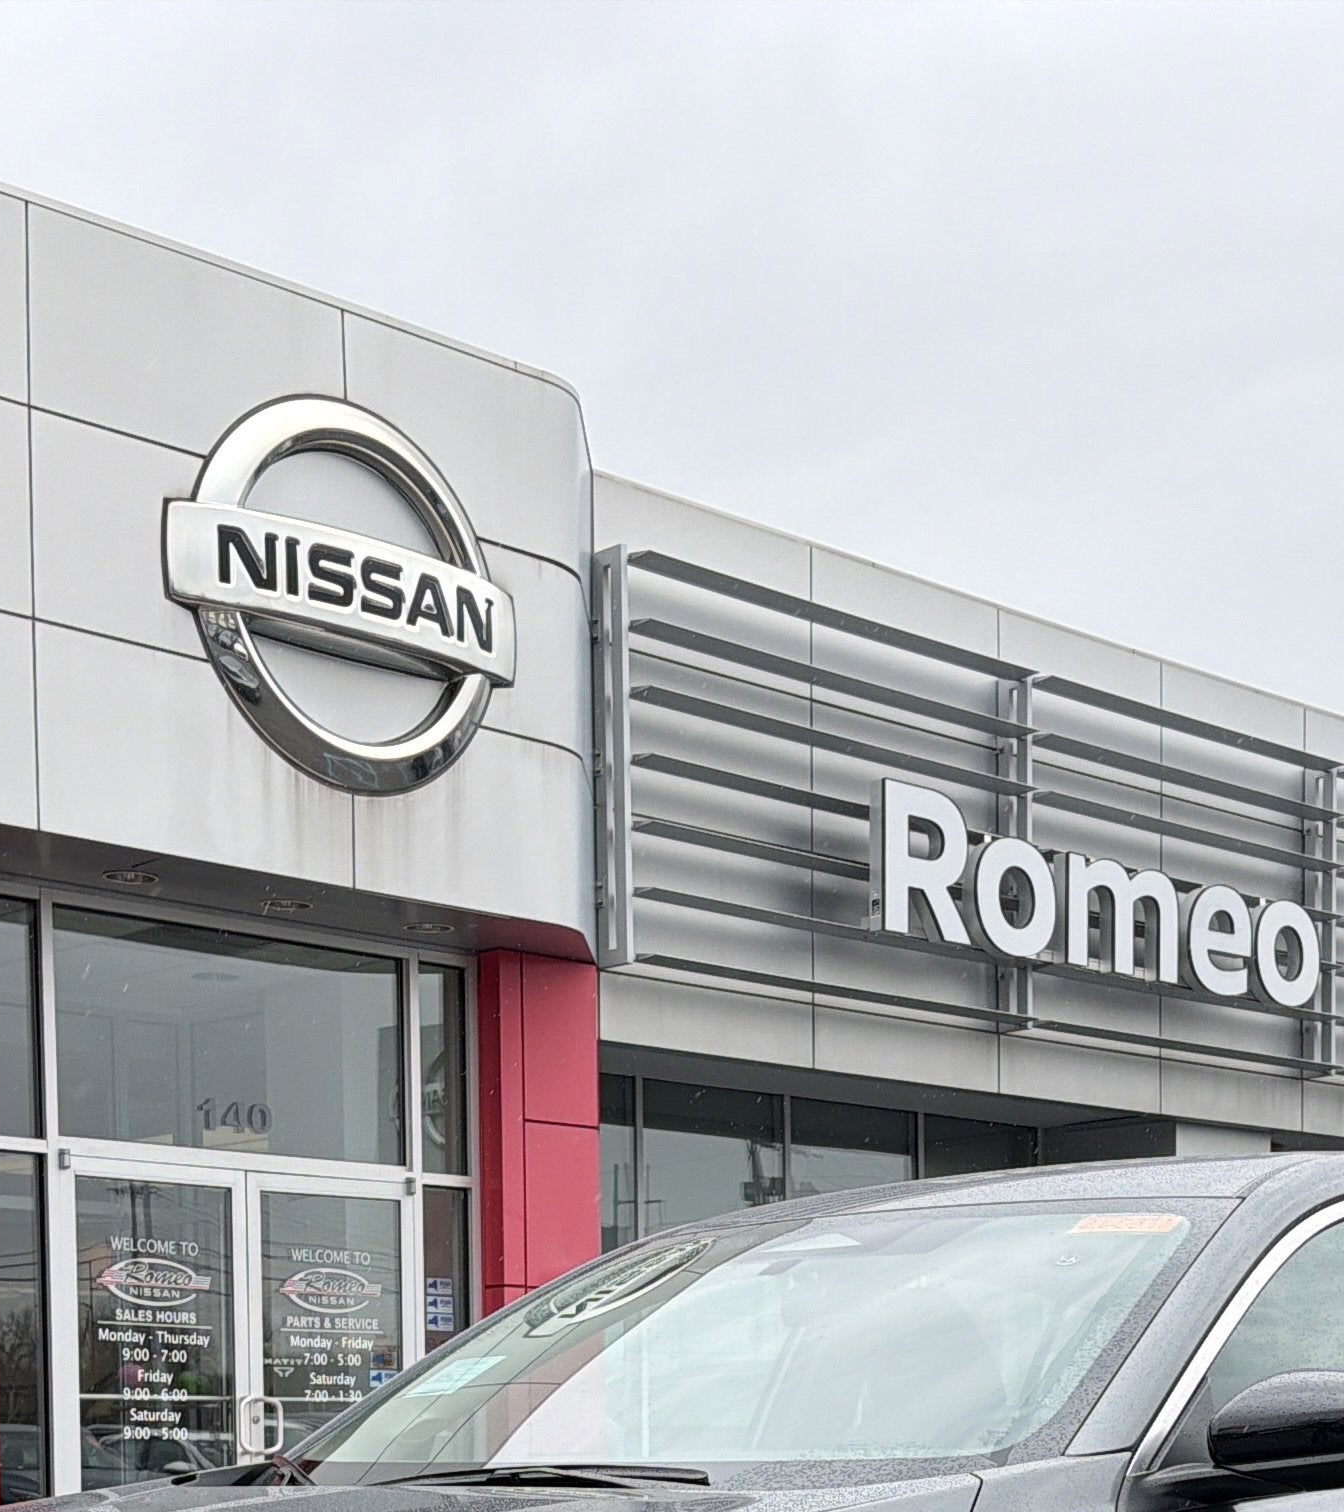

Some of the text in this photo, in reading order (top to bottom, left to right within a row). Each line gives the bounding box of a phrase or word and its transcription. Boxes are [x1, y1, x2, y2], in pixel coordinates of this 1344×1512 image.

[216, 523, 495, 654] NISSAN
[874, 776, 1321, 1008] Romeo
[197, 1098, 273, 1135] 140
[110, 1235, 199, 1257] WELCOME TO
[290, 1248, 371, 1265] WELCOME TO
[122, 1260, 193, 1286] Romeo
[303, 1271, 366, 1294] Romeo
[129, 1287, 180, 1299] NISSAN
[308, 1296, 355, 1306] NISSAN
[115, 1308, 197, 1325] SALES HOURS
[286, 1316, 379, 1330] PARTS & SERVICE
[98, 1328, 146, 1345] Monday
[157, 1330, 210, 1348] Thursday
[290, 1335, 333, 1351] Monday
[341, 1337, 374, 1351] Friday
[122, 1348, 149, 1362] 9:00
[161, 1350, 187, 1363] 7:00
[303, 1353, 328, 1366] 7:00
[337, 1354, 362, 1366] 5:00
[137, 1369, 174, 1385] Friday
[310, 1372, 356, 1387] Saturday
[123, 1387, 150, 1401] 9:00
[160, 1388, 188, 1402] 6:00
[304, 1390, 329, 1402] 7:00
[338, 1390, 363, 1402] 1:30
[129, 1408, 182, 1424] Saturday
[123, 1427, 151, 1440] 9:00
[161, 1427, 188, 1441] 5:00
